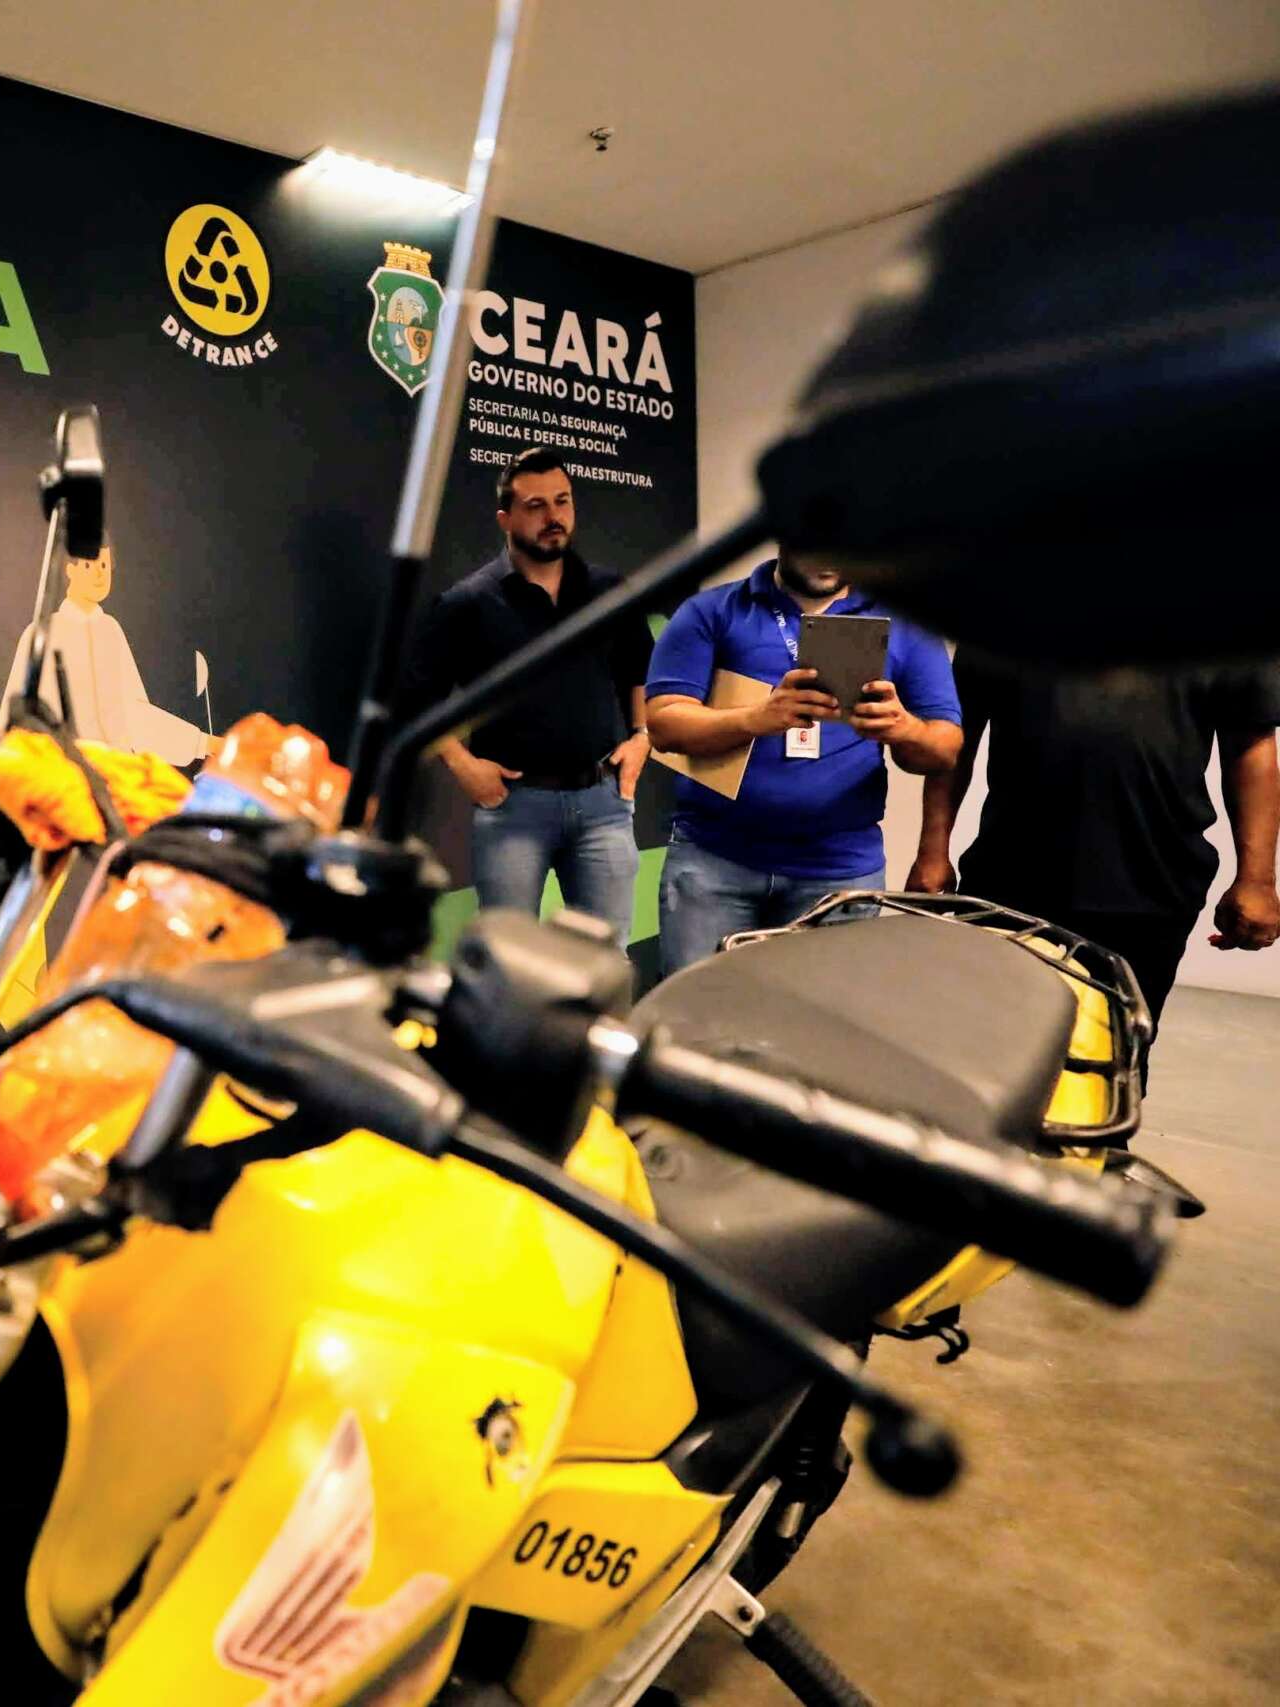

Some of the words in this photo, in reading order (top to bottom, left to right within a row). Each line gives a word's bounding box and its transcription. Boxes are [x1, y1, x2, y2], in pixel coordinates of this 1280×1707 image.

[469, 290, 673, 393] CEARÁ
[468, 360, 568, 400] GOVERNO
[573, 381, 601, 406] DO
[606, 388, 674, 420] ESTADO
[469, 397, 540, 423] SECRETARIA
[542, 411, 559, 426] DA
[560, 414, 627, 441] SEGURANÇA
[469, 416, 521, 439] PÚBLICA
[524, 428, 531, 441] E
[533, 430, 577, 448] DEFESA
[578, 437, 618, 456] SOCIAL
[469, 447, 522, 467] SECRET
[514, 1521, 638, 1588] 01856
